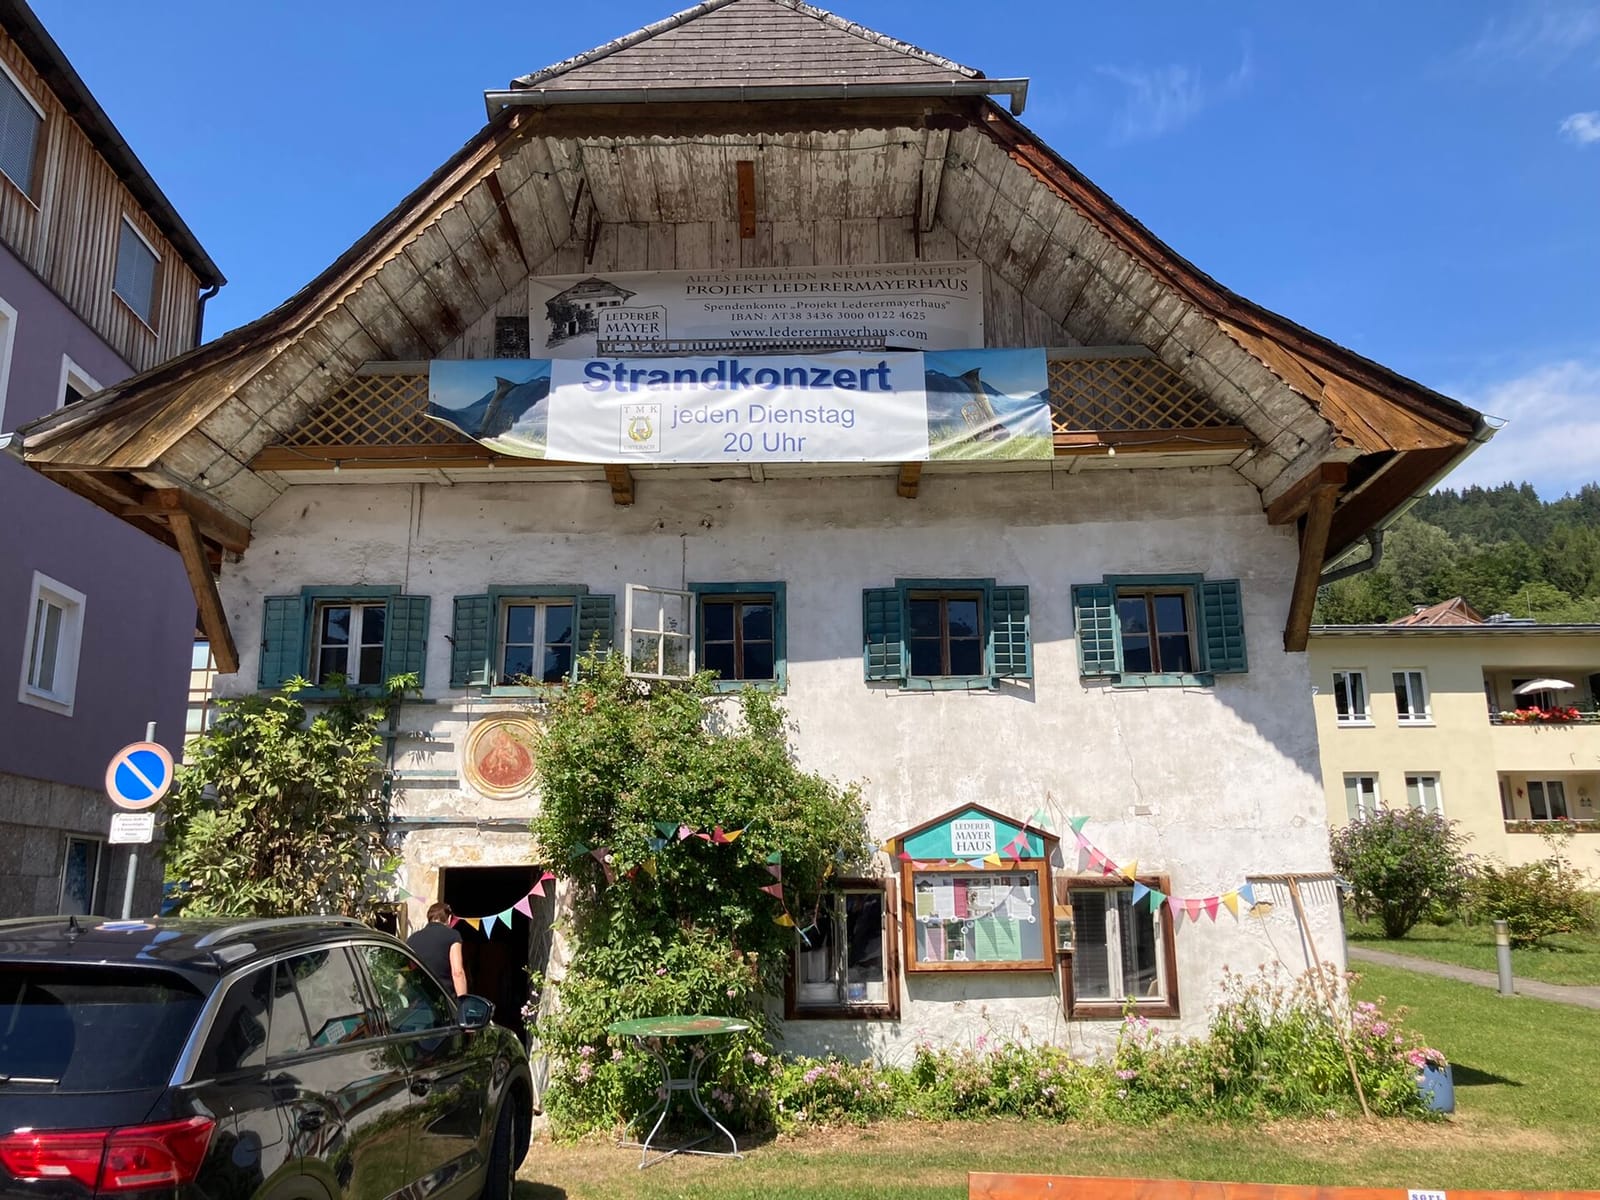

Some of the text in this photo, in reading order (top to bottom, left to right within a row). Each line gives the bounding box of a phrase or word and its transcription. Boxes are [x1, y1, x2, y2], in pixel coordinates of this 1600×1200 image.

[686, 266, 968, 283] ALTES ERHALTEN NEUES SCHAFFEN
[686, 278, 969, 296] PROJEKT LEDERERMAYERHAUS
[703, 302, 787, 312] Spendenkonto
[606, 311, 660, 321] LEDERER
[731, 311, 926, 321] IBAN: AT38 3436 3000 0122 4625
[605, 322, 660, 333] MAYER
[730, 326, 929, 340] www.lederermayerhaus.com
[583, 360, 893, 392] Strandkonzert
[623, 406, 631, 414] T
[635, 406, 645, 414] M
[671, 404, 855, 429] jeden Dienstag
[723, 432, 807, 453] 20 Uhr
[956, 831, 991, 840] MAYER
[957, 841, 992, 851] HAUS
